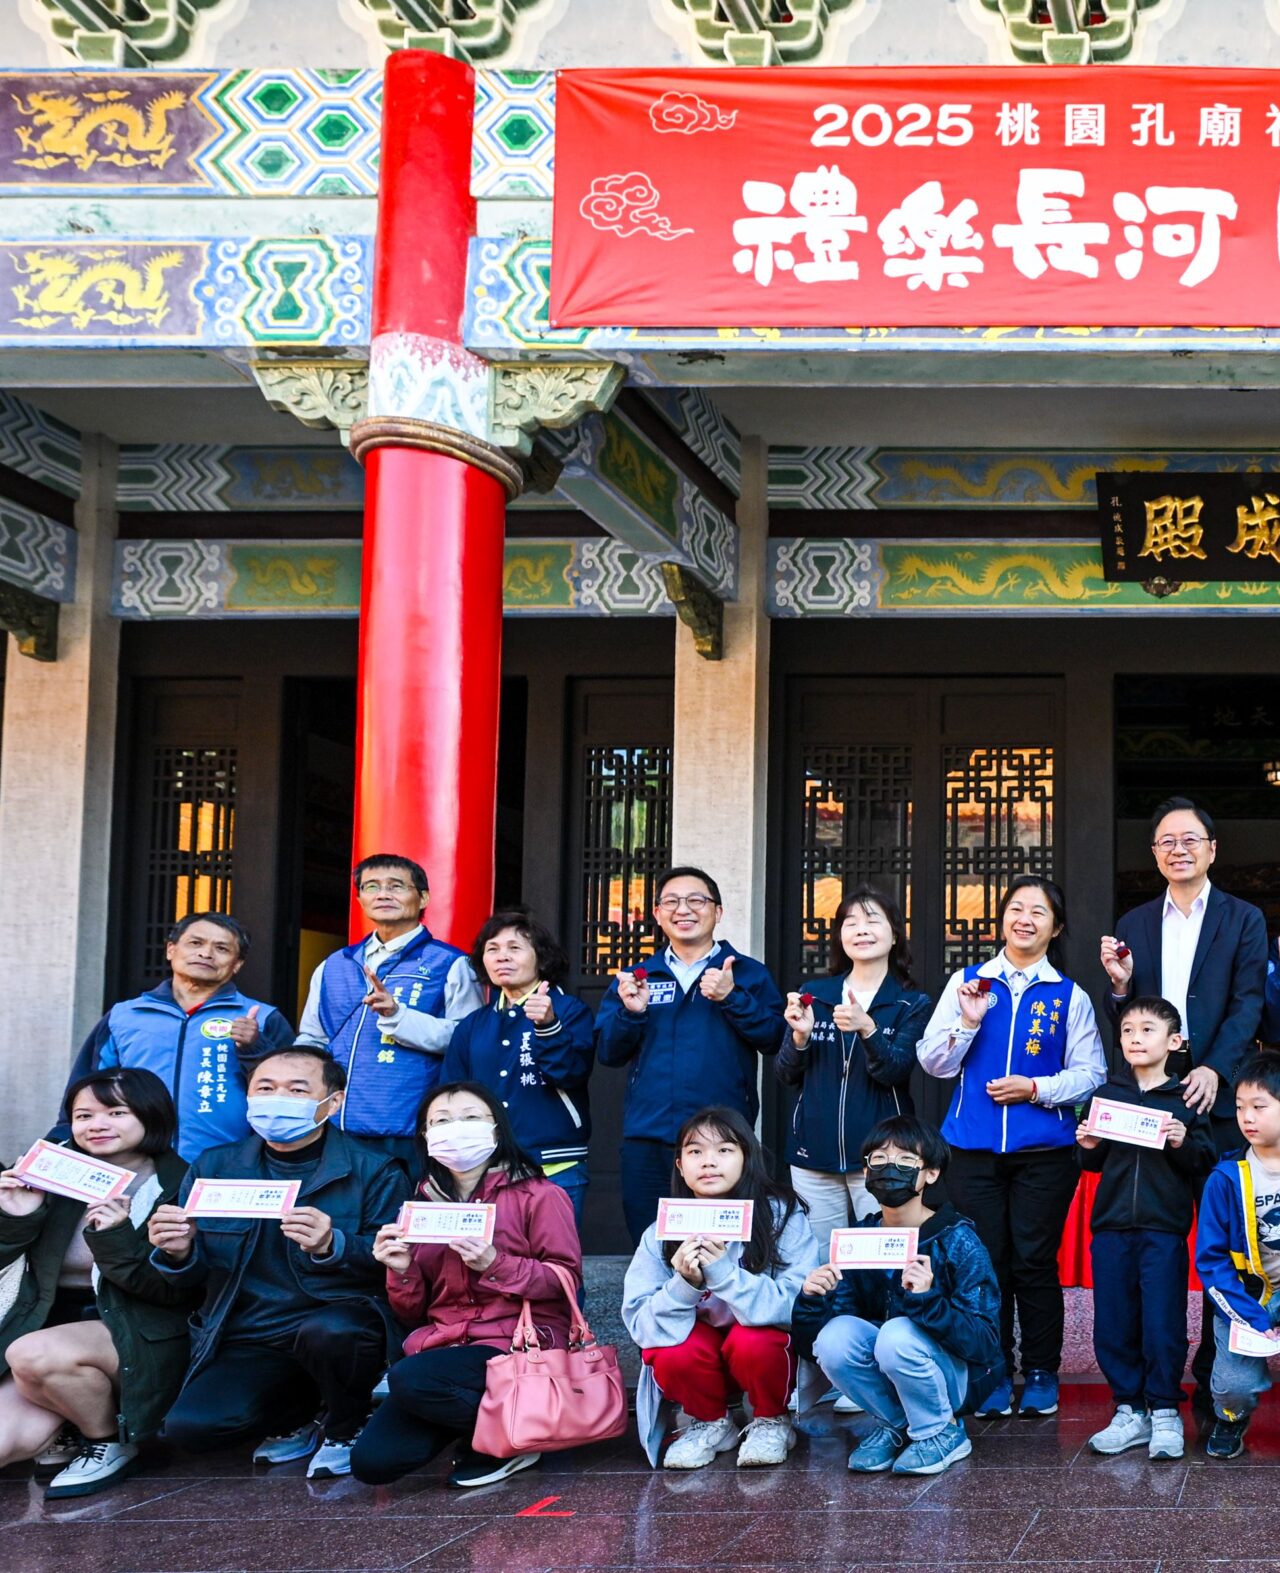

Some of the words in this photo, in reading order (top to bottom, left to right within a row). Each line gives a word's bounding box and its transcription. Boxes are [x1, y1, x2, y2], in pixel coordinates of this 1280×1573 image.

[810, 103, 975, 148] 2025
[732, 165, 1239, 291] 禮樂長河
